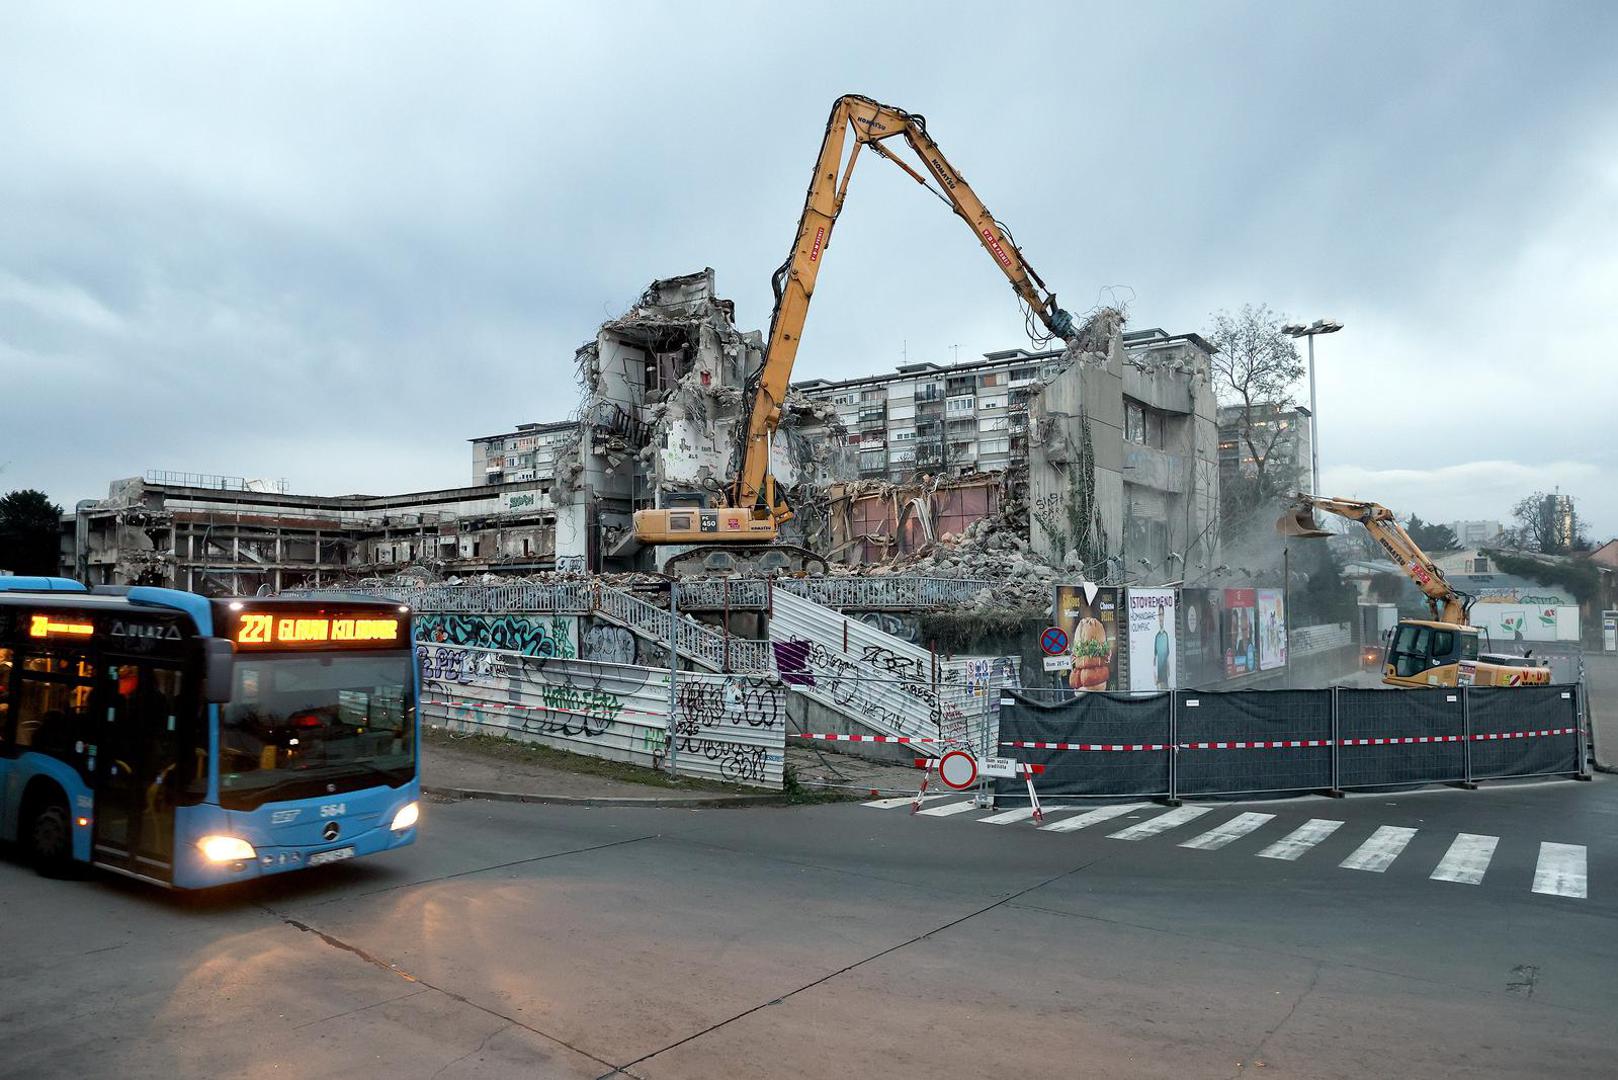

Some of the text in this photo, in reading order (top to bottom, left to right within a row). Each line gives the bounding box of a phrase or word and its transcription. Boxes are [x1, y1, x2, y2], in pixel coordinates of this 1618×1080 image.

[857, 116, 887, 131] KOMATSU
[931, 158, 956, 190] KOMATSU
[1379, 537, 1406, 566] KOMATSU
[238, 614, 273, 643] 221
